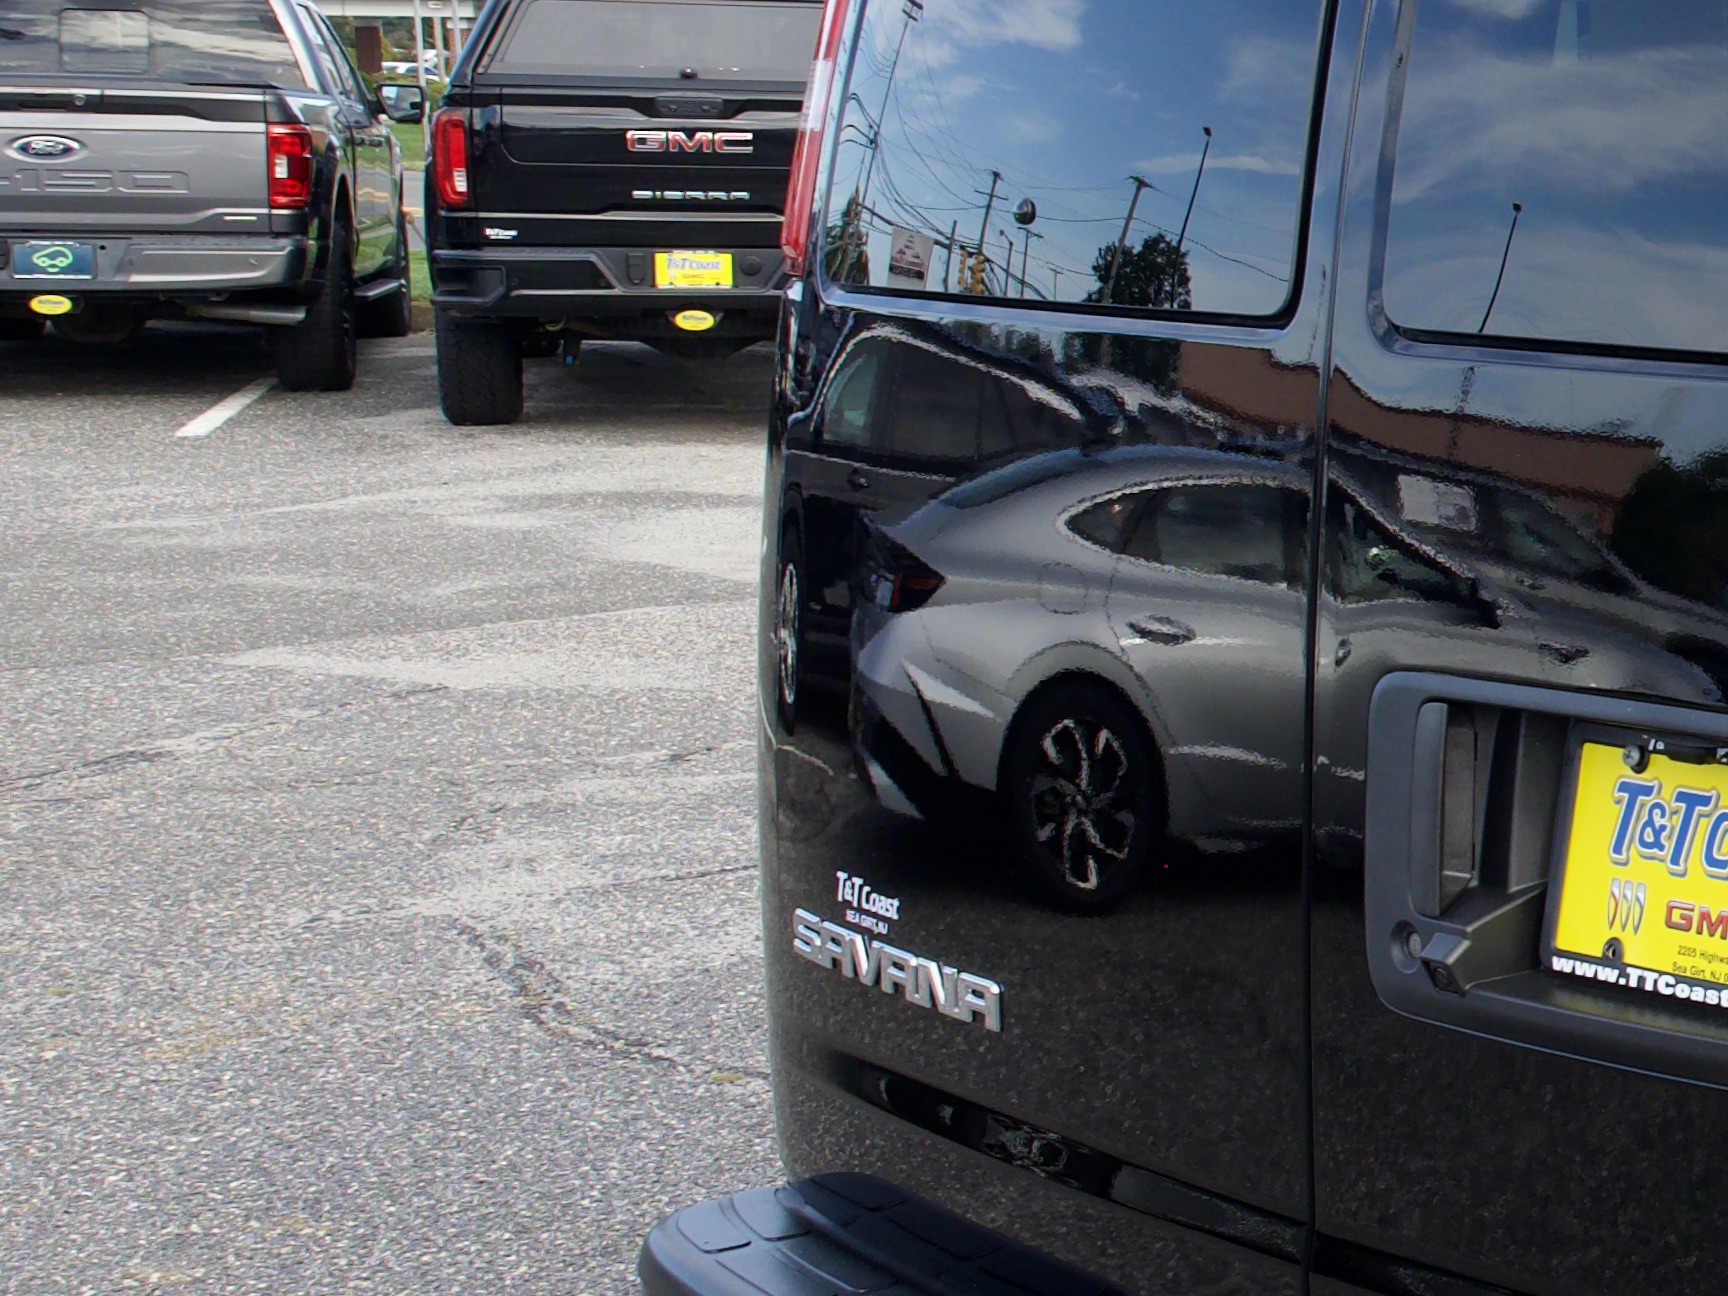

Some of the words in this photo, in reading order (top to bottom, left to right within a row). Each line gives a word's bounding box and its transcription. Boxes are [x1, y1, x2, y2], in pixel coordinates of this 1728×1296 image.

[625, 130, 754, 153] GMC
[1608, 778, 1719, 879] T&T
[836, 870, 864, 908] T&T
[861, 885, 900, 920] Coast
[793, 907, 1004, 1032] SAVANA
[1672, 961, 1687, 974] Sea
[1709, 970, 1722, 983] NJ
